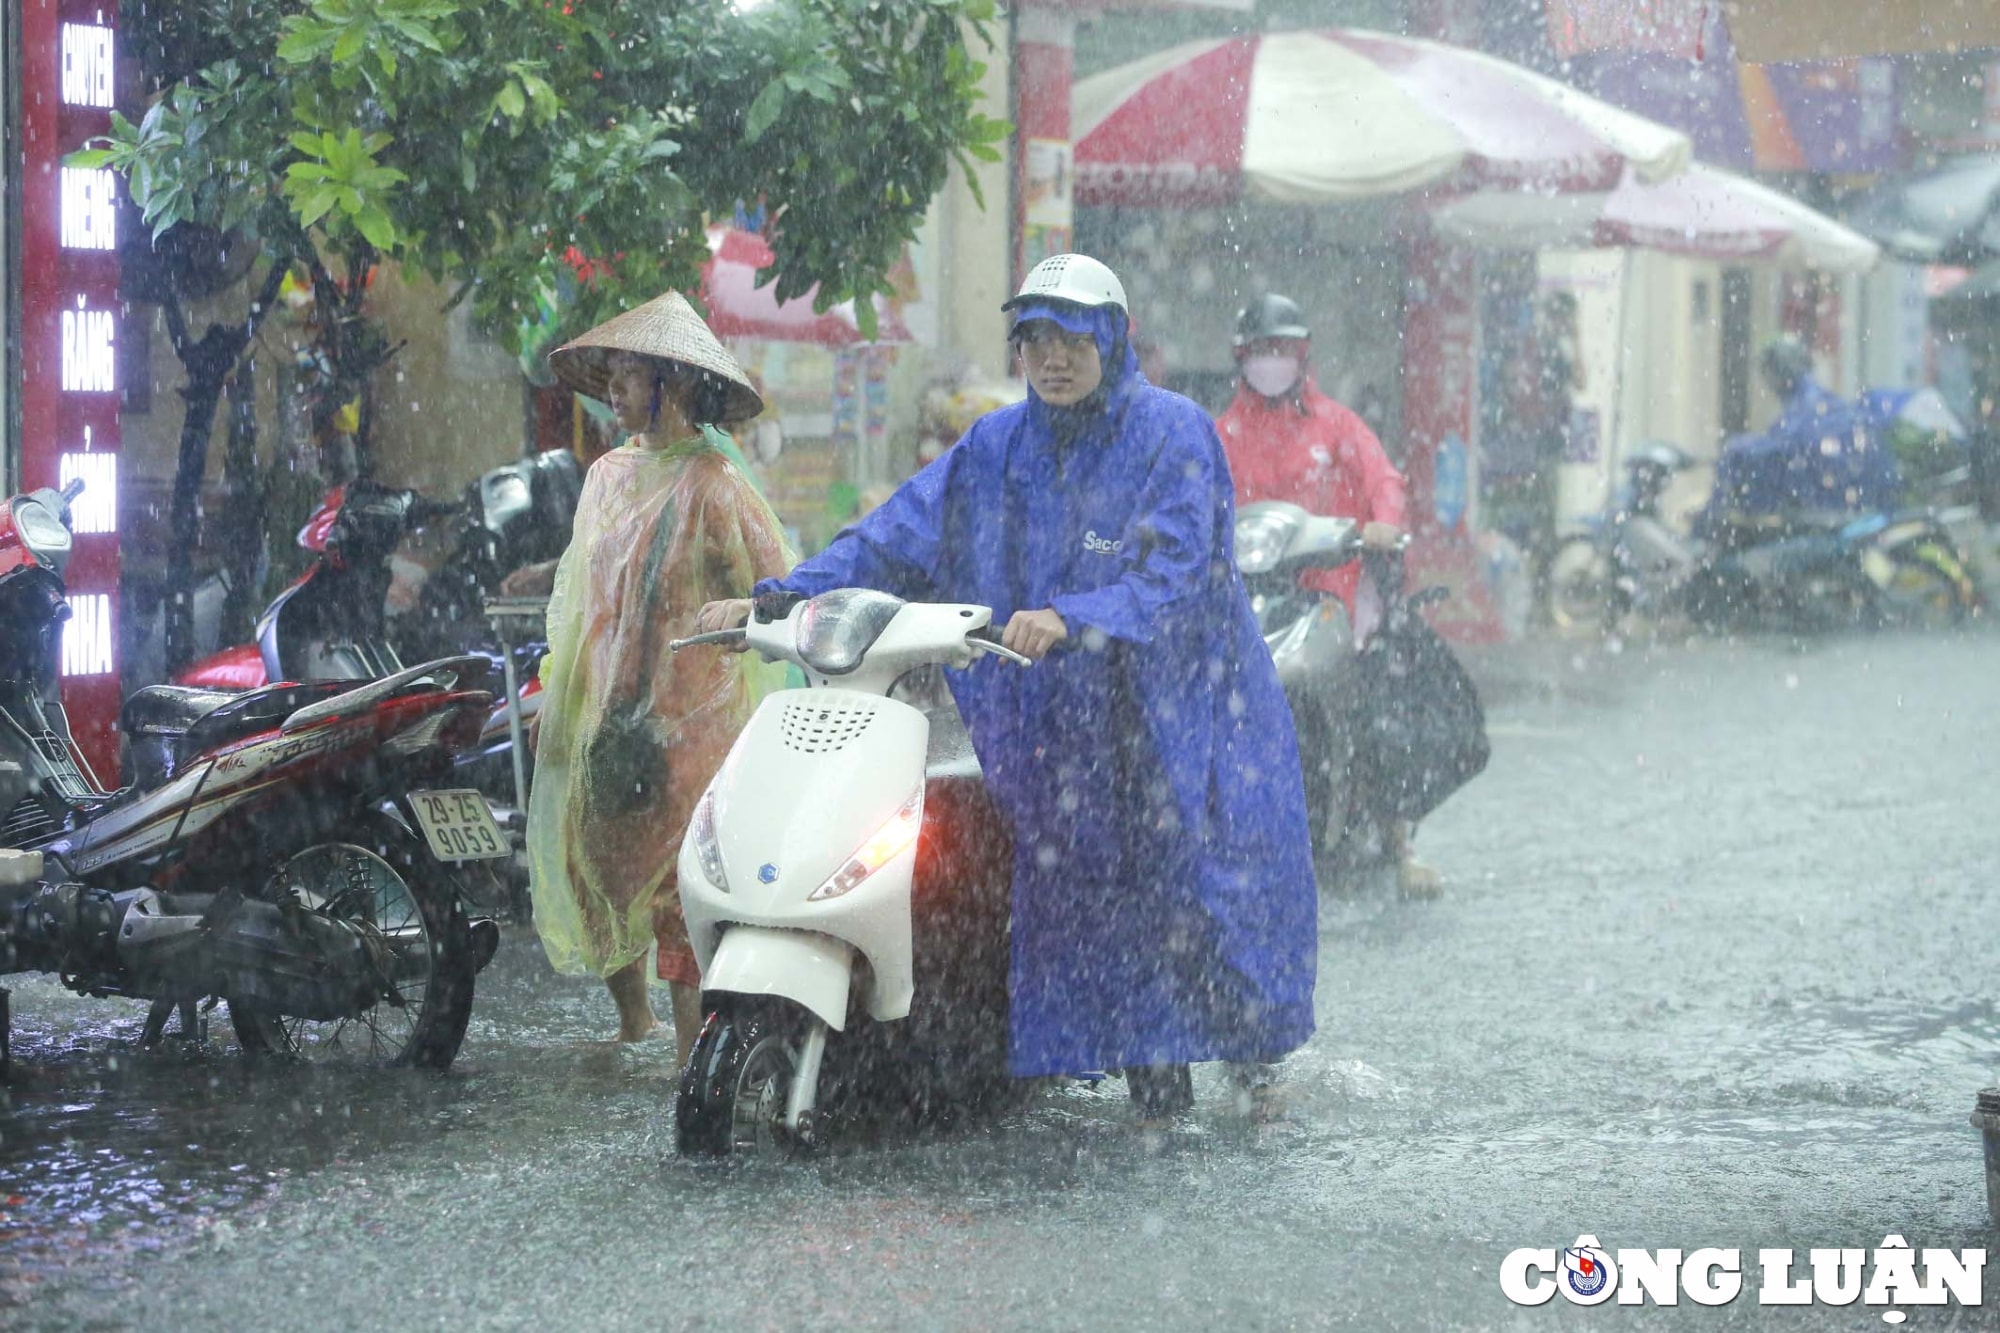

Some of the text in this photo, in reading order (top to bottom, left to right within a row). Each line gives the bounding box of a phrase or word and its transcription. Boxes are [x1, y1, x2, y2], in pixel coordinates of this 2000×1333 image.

[62, 9, 114, 107] CHUYÊN
[62, 294, 114, 392] RĂNG
[62, 594, 112, 676] NHA
[436, 826, 497, 855] 9059
